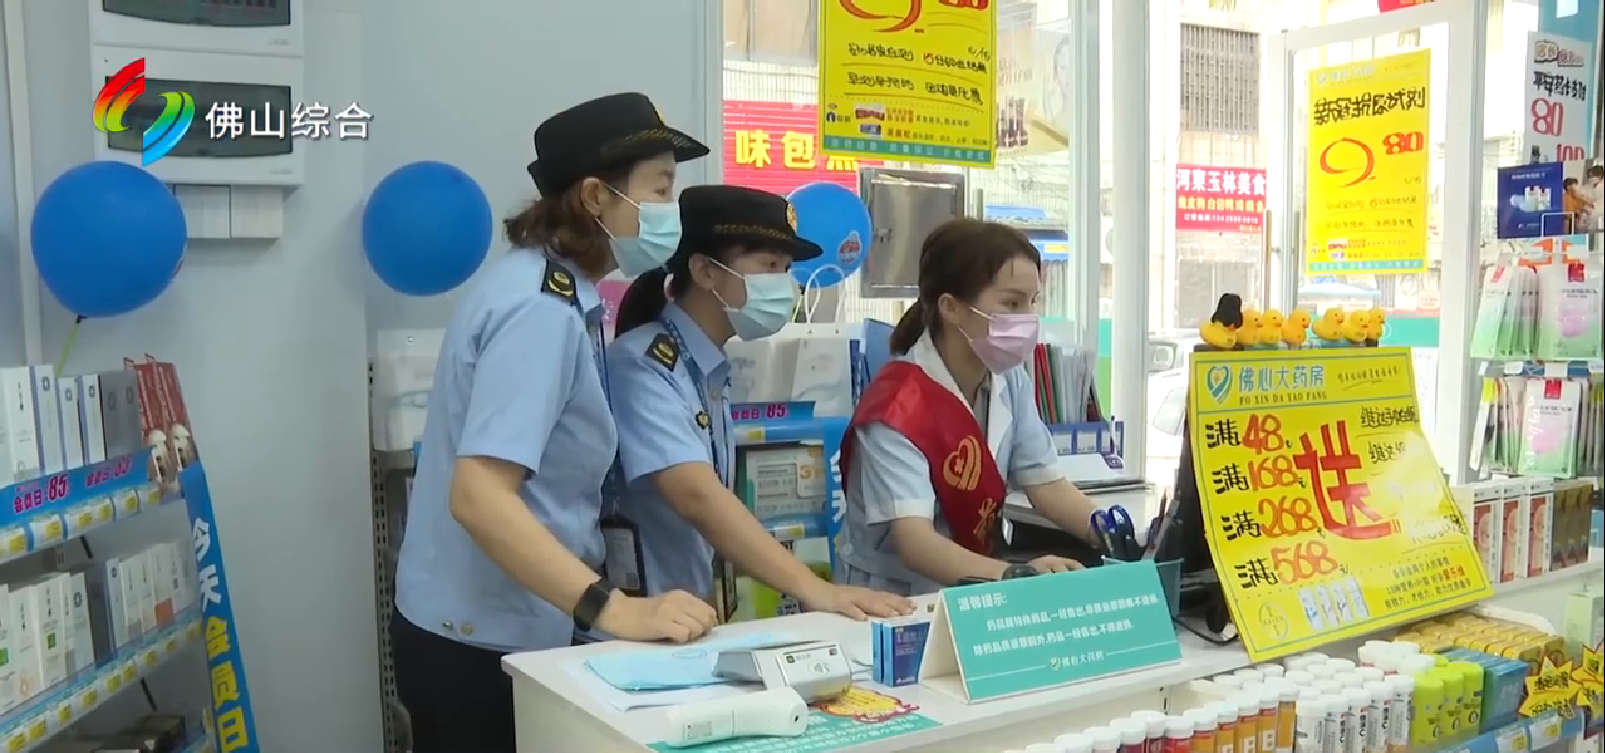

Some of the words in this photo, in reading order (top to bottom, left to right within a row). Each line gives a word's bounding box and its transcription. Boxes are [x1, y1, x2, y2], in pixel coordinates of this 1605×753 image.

[1531, 97, 1563, 136] 80
[1239, 365, 1325, 393] 佛心大药房
[48, 473, 68, 502] 85
